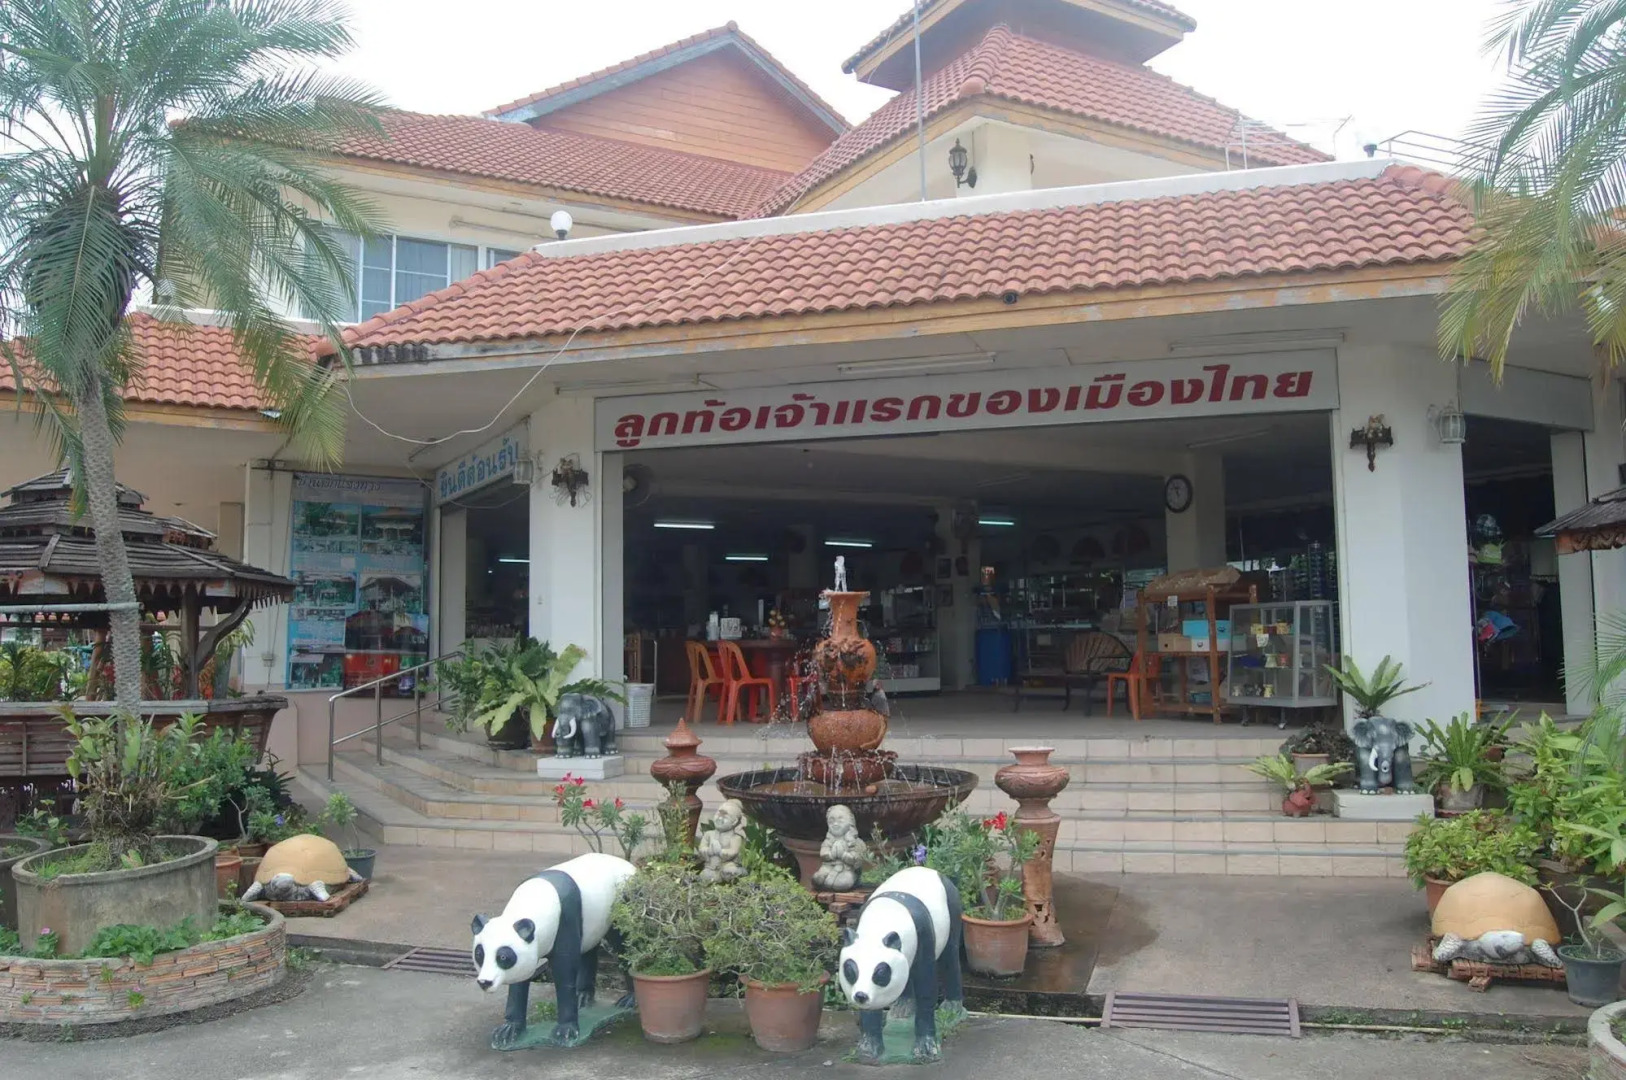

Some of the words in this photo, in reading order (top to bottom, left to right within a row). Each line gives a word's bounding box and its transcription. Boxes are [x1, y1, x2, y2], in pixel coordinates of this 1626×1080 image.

[614, 364, 1313, 448] ลูกท้อเจ้าแรกของเมืองไทย
